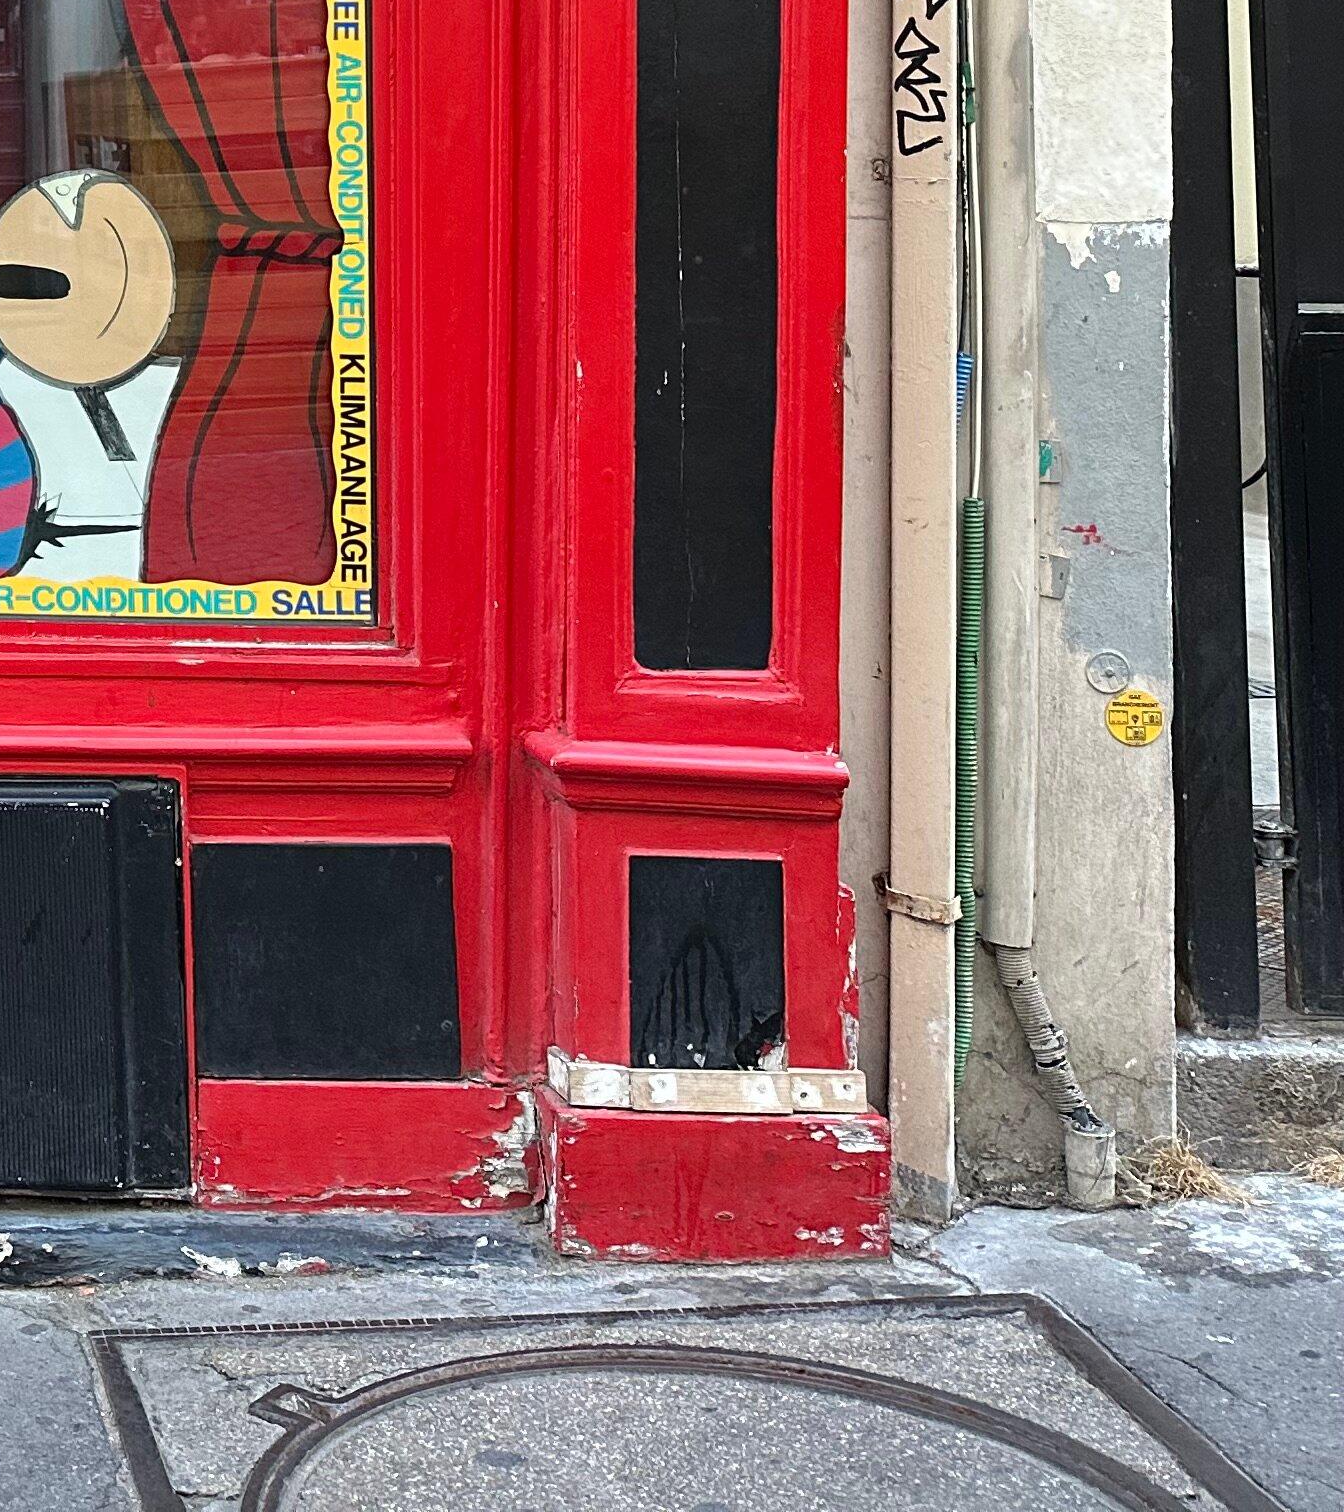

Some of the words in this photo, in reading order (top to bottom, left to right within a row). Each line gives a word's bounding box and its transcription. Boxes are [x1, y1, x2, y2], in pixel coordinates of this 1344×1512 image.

[336, 52, 365, 339] AIR-CONDITONED
[339, 353, 368, 583] KLIMAANLAGE
[272, 589, 371, 616] SALLE
